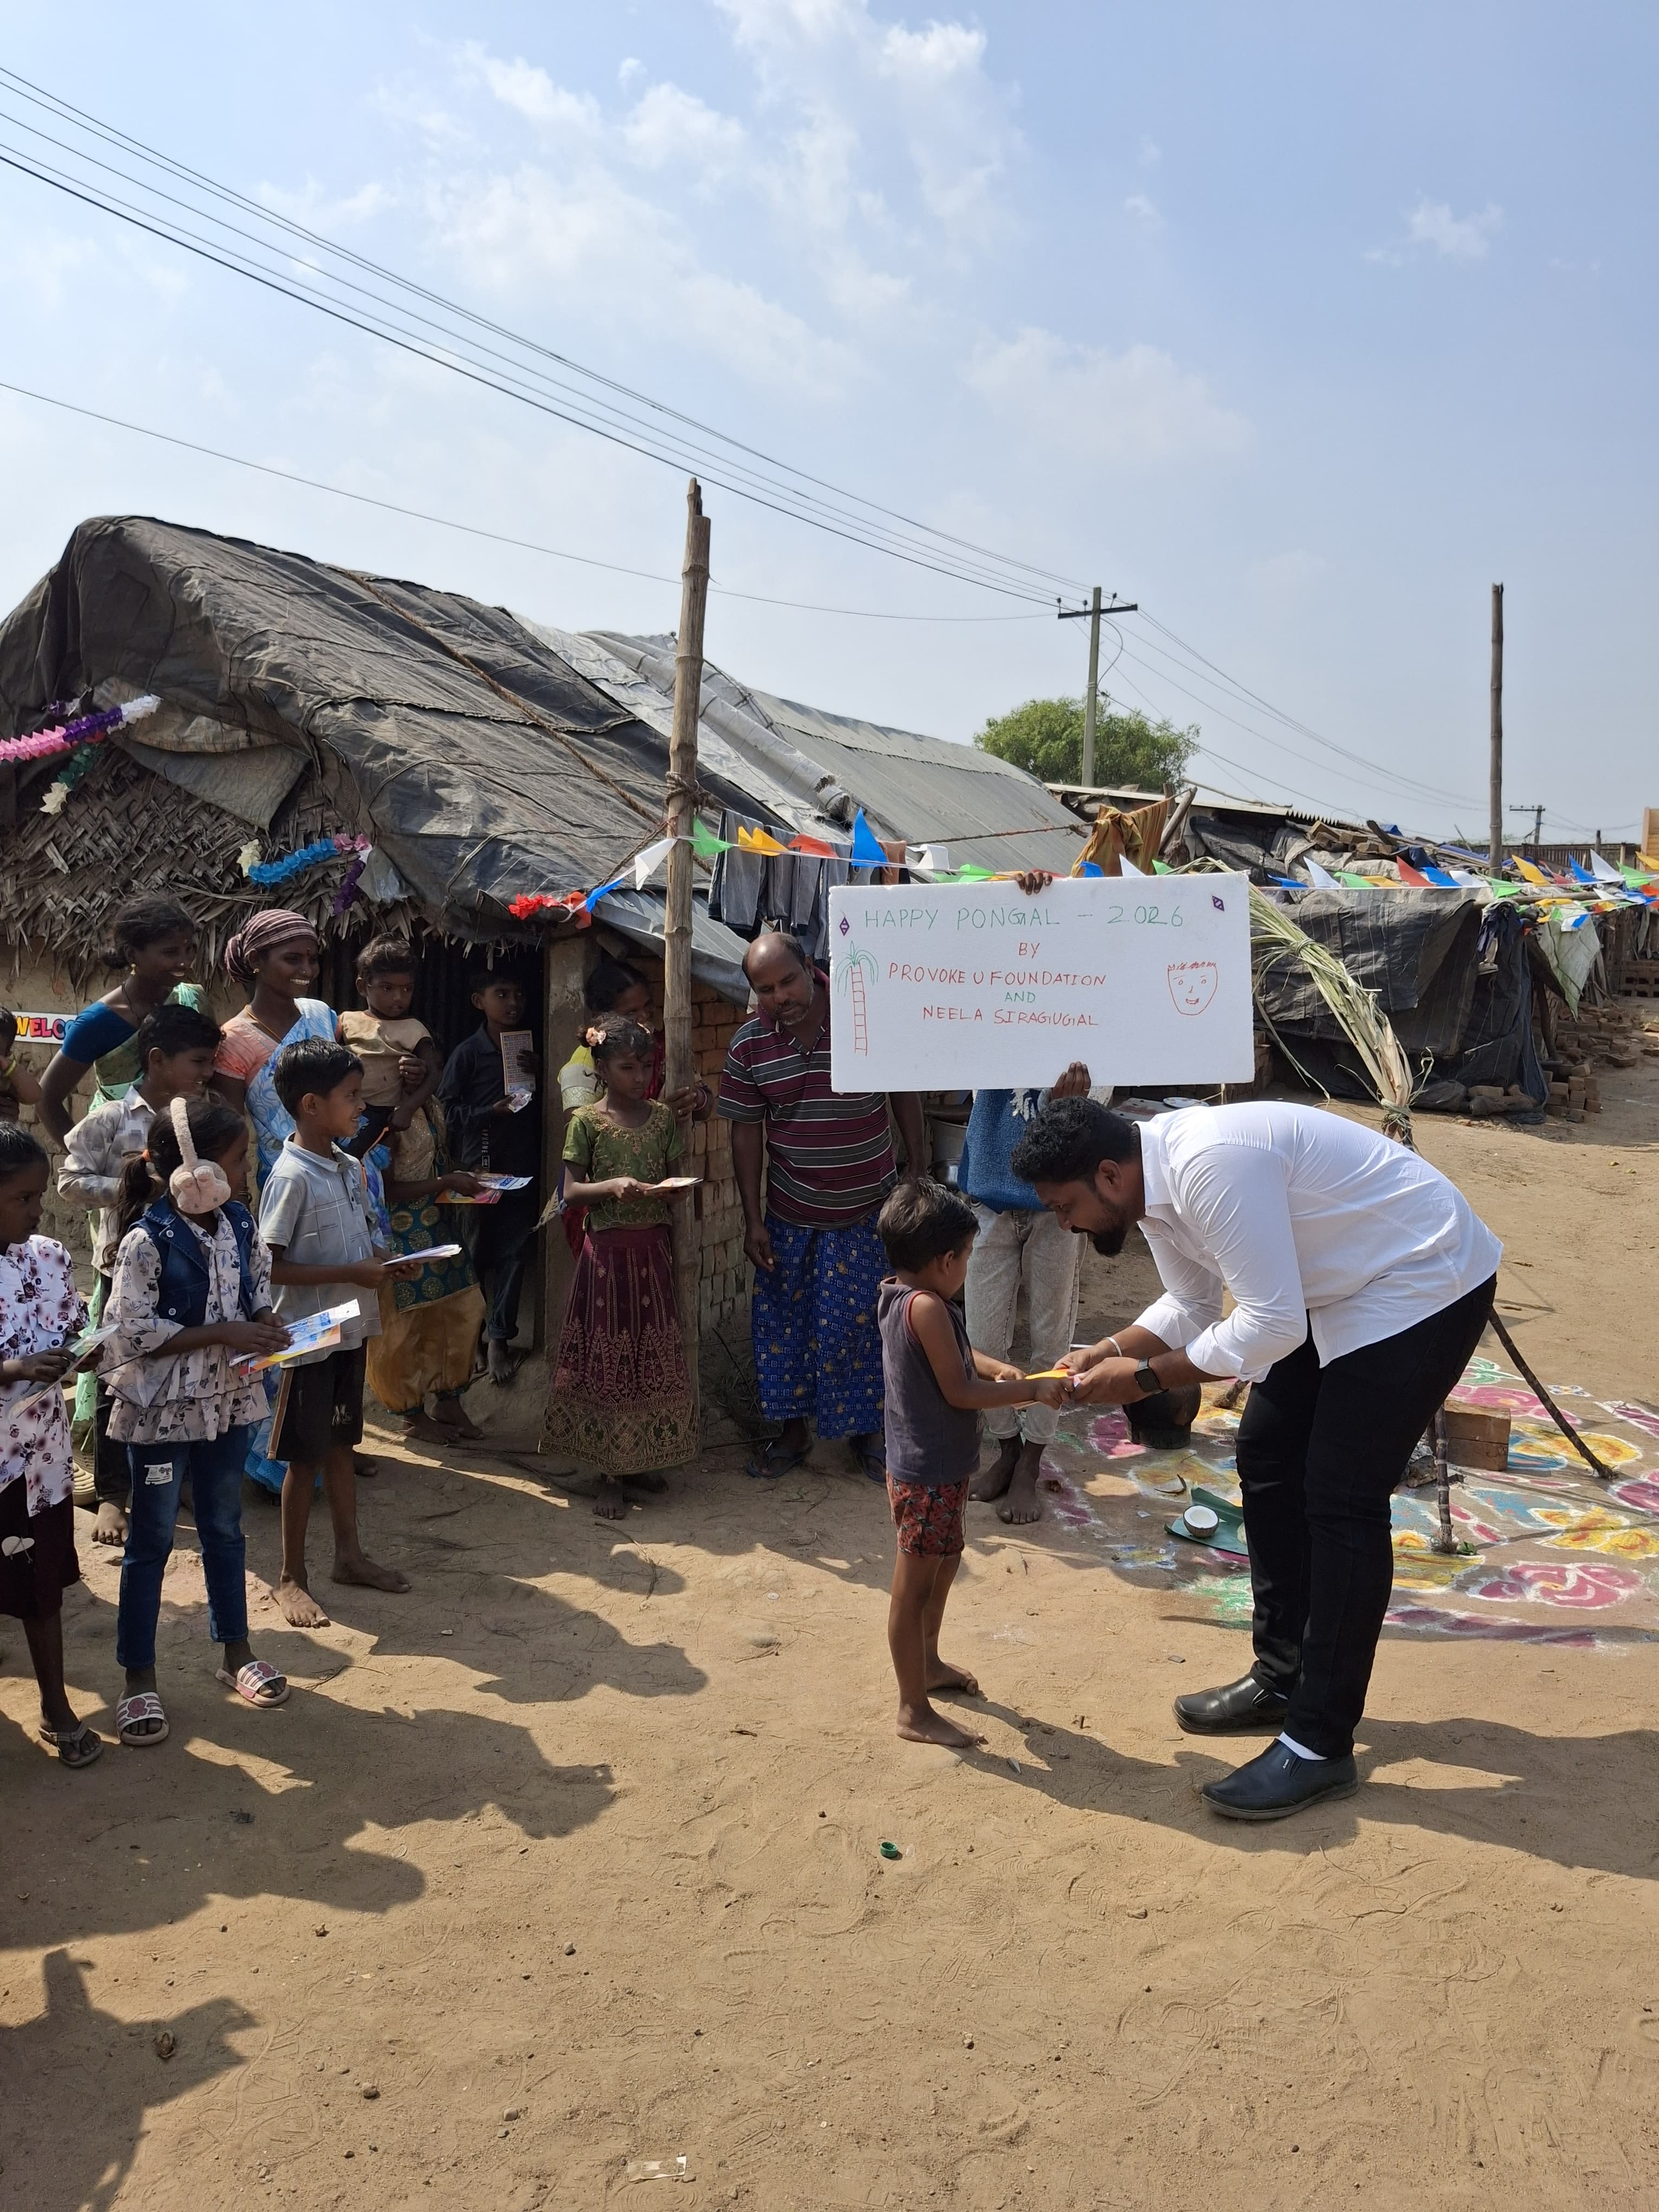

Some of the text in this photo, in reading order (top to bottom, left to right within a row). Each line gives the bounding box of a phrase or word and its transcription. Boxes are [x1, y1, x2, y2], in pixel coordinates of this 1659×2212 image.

[865, 909, 938, 930] HAPPY
[957, 907, 1060, 930] PONGAL
[1108, 905, 1183, 927] 2026
[1019, 942, 1040, 959] BY
[889, 962, 966, 983] PROVOKE
[1005, 991, 1036, 1003] AND
[923, 1005, 1099, 1026] NEELA SIRAGUGAL
